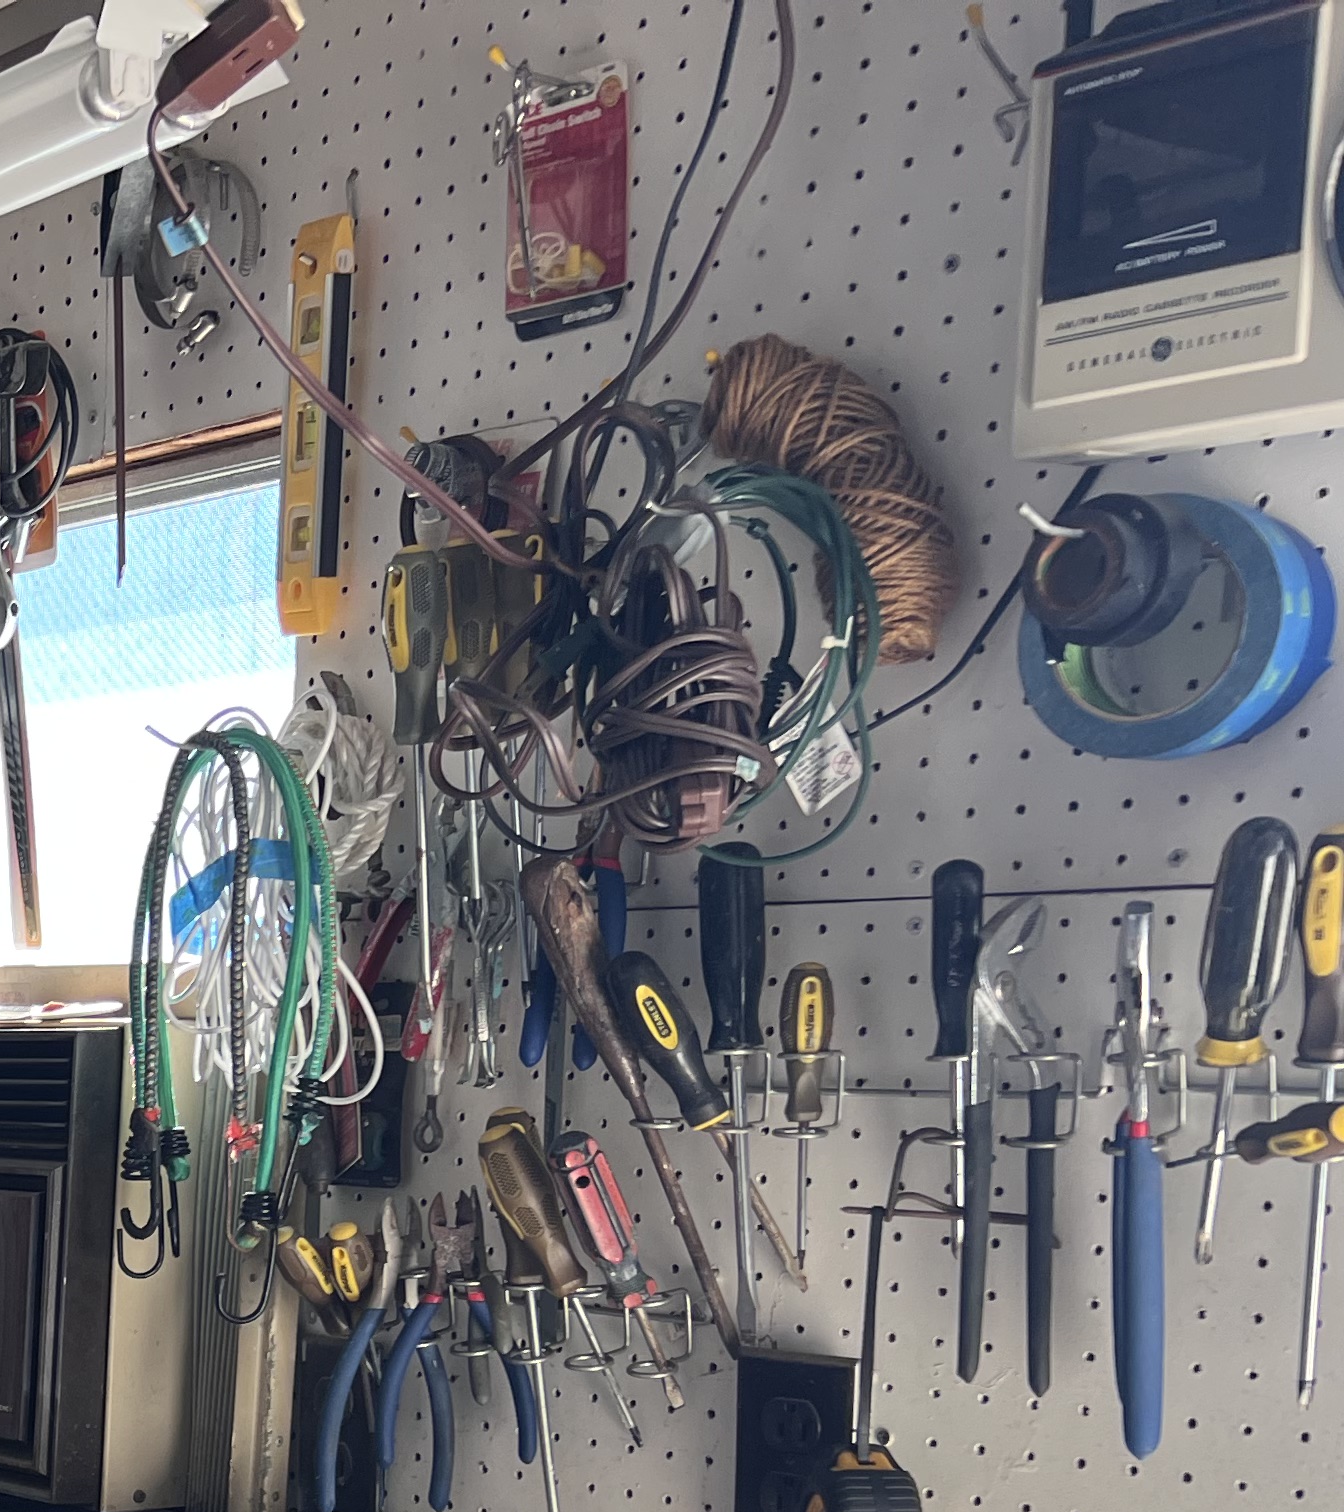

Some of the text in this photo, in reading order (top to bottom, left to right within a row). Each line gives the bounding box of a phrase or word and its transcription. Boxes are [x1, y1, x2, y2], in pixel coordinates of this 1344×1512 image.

[1101, 306, 1141, 322] RADIO
[1142, 291, 1209, 314] CASSETTE
[1212, 278, 1281, 299] RECORDER
[1067, 346, 1147, 373] GENERAL
[1175, 324, 1263, 352] ELECTRIC
[643, 999, 670, 1037] STANLEY
